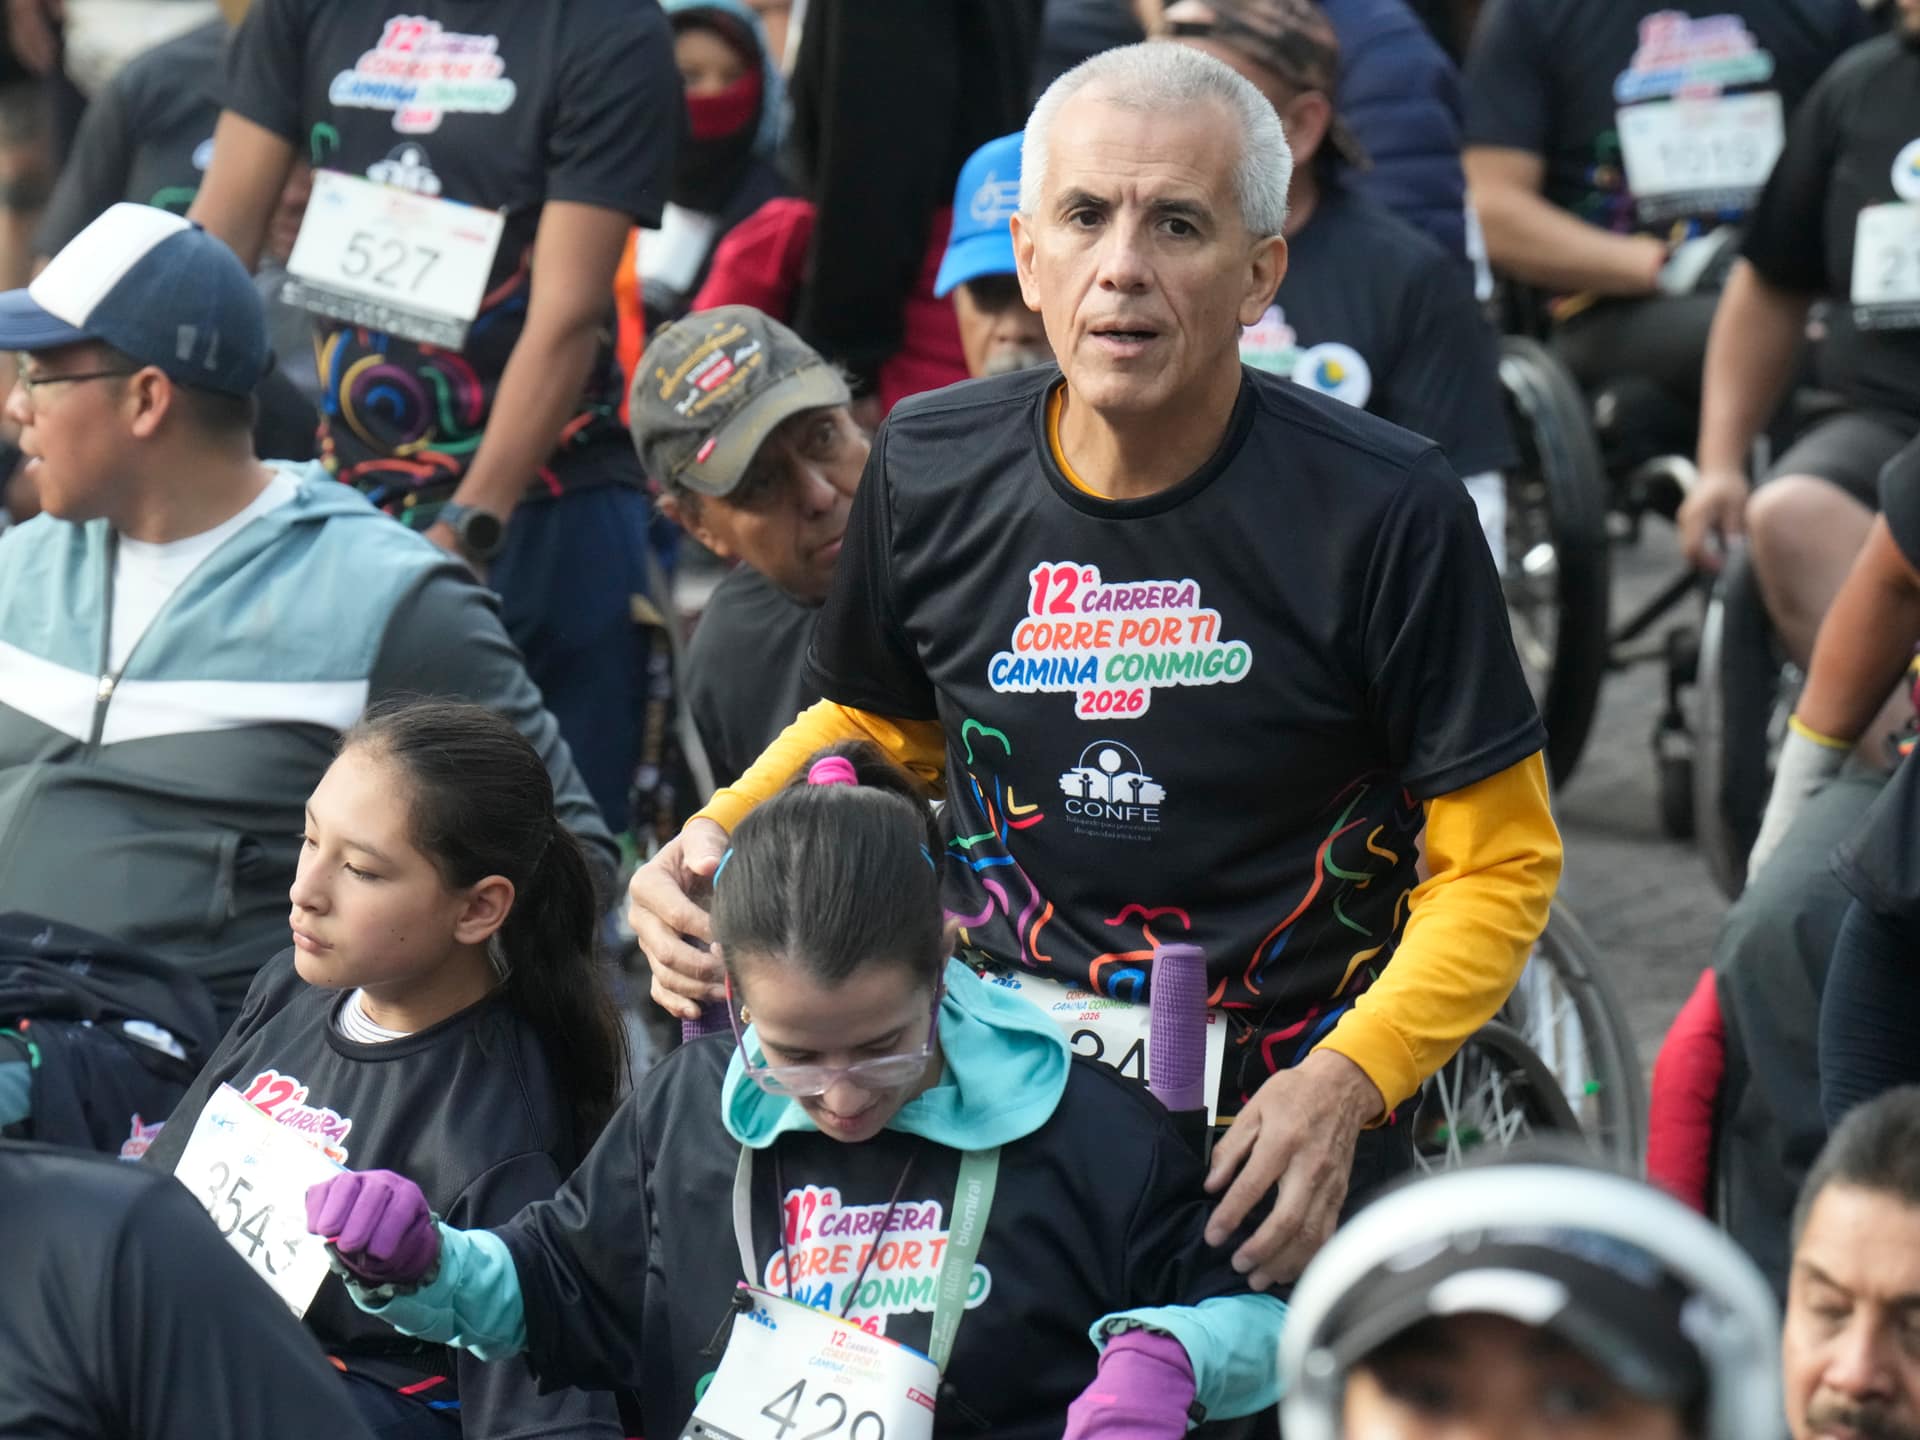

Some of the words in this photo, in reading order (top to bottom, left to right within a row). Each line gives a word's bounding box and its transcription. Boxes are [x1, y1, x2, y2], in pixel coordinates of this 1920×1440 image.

[341, 231, 440, 292] 527
[1081, 584, 1195, 613] CARRERA
[1015, 619, 1115, 652] CORRE
[1118, 617, 1182, 647] POR
[1187, 614, 1216, 644] TI
[991, 655, 1099, 686] CAMINA
[1104, 646, 1248, 683] CONMIGO
[1080, 688, 1144, 714] 2026
[1064, 799, 1161, 823] CONFE
[1079, 1012, 1101, 1021] 2026
[818, 1206, 936, 1237] CARRERA
[857, 1240, 923, 1273] POR
